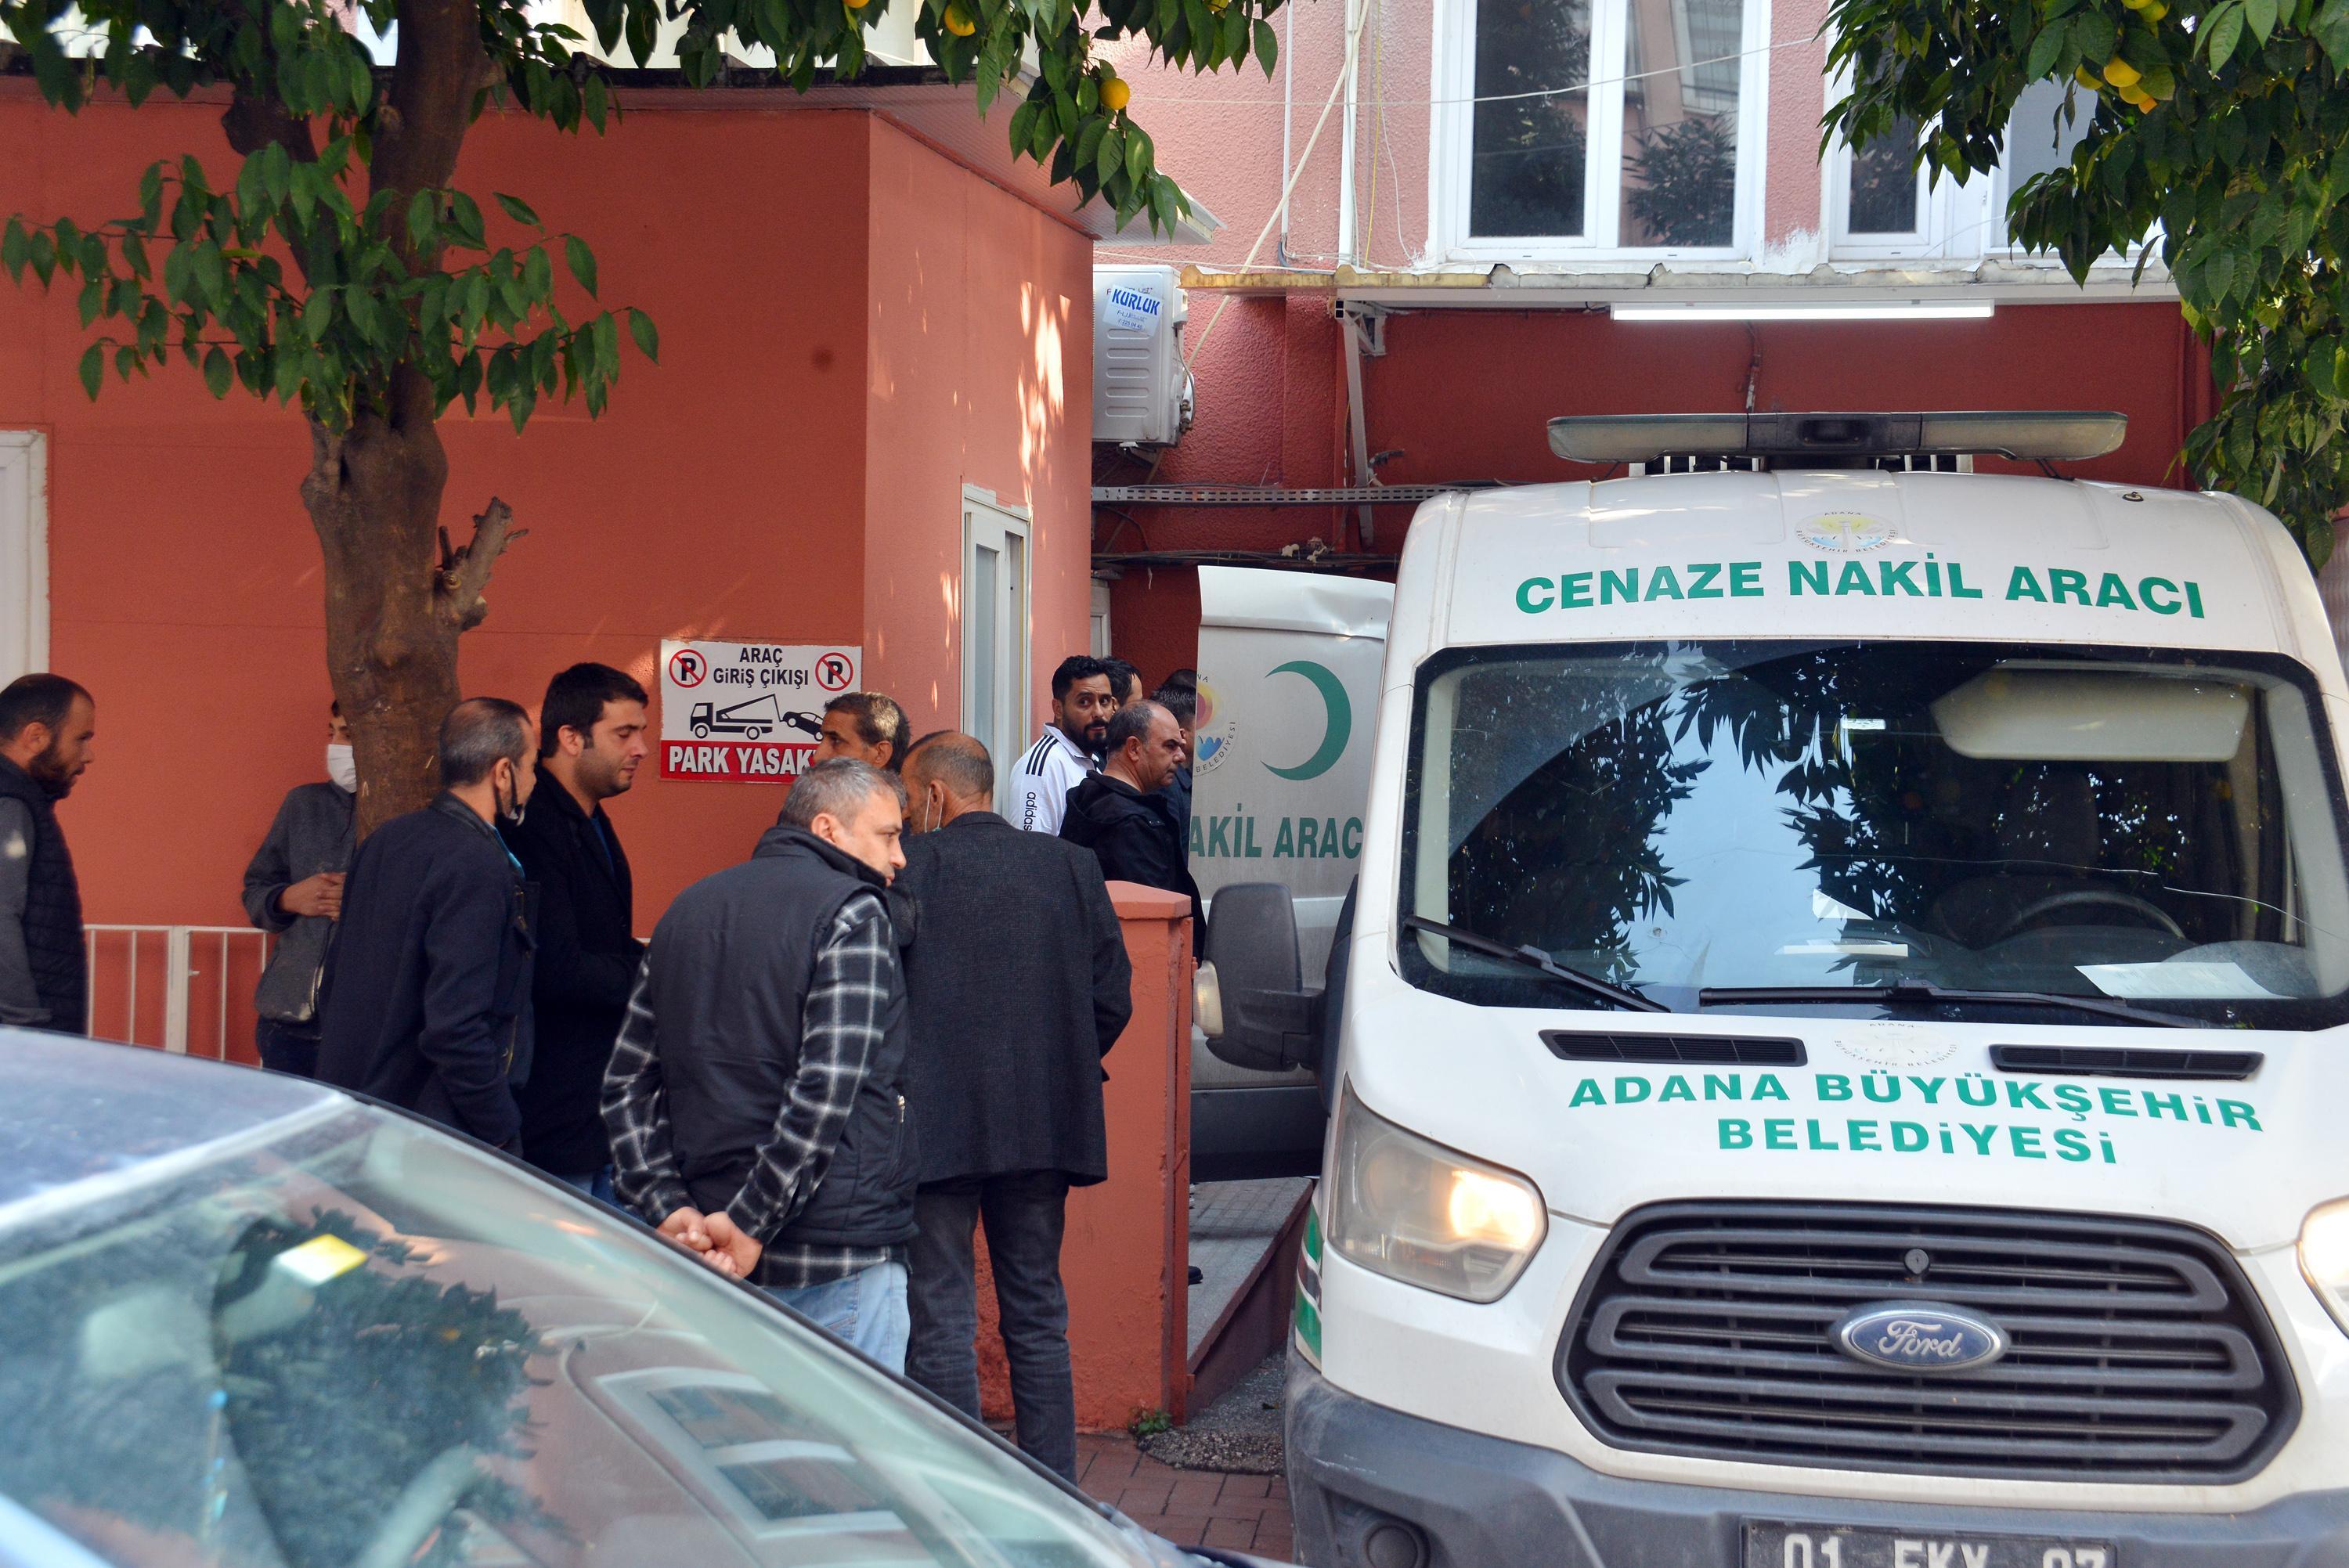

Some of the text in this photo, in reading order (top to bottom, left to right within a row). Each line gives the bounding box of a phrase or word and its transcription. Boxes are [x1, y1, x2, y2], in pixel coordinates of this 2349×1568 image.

[1112, 288, 1160, 315] KURLUK
[1515, 552, 2205, 618] CENAZE NAKİL ARACI
[739, 647, 783, 667] ARAÇ
[760, 669, 809, 689] ÇIKIŞI
[669, 746, 817, 775] PARK YASAK
[1023, 791, 1037, 831] adidas
[1568, 1073, 1791, 1108] ADANA
[1878, 1319, 1964, 1358] Ford
